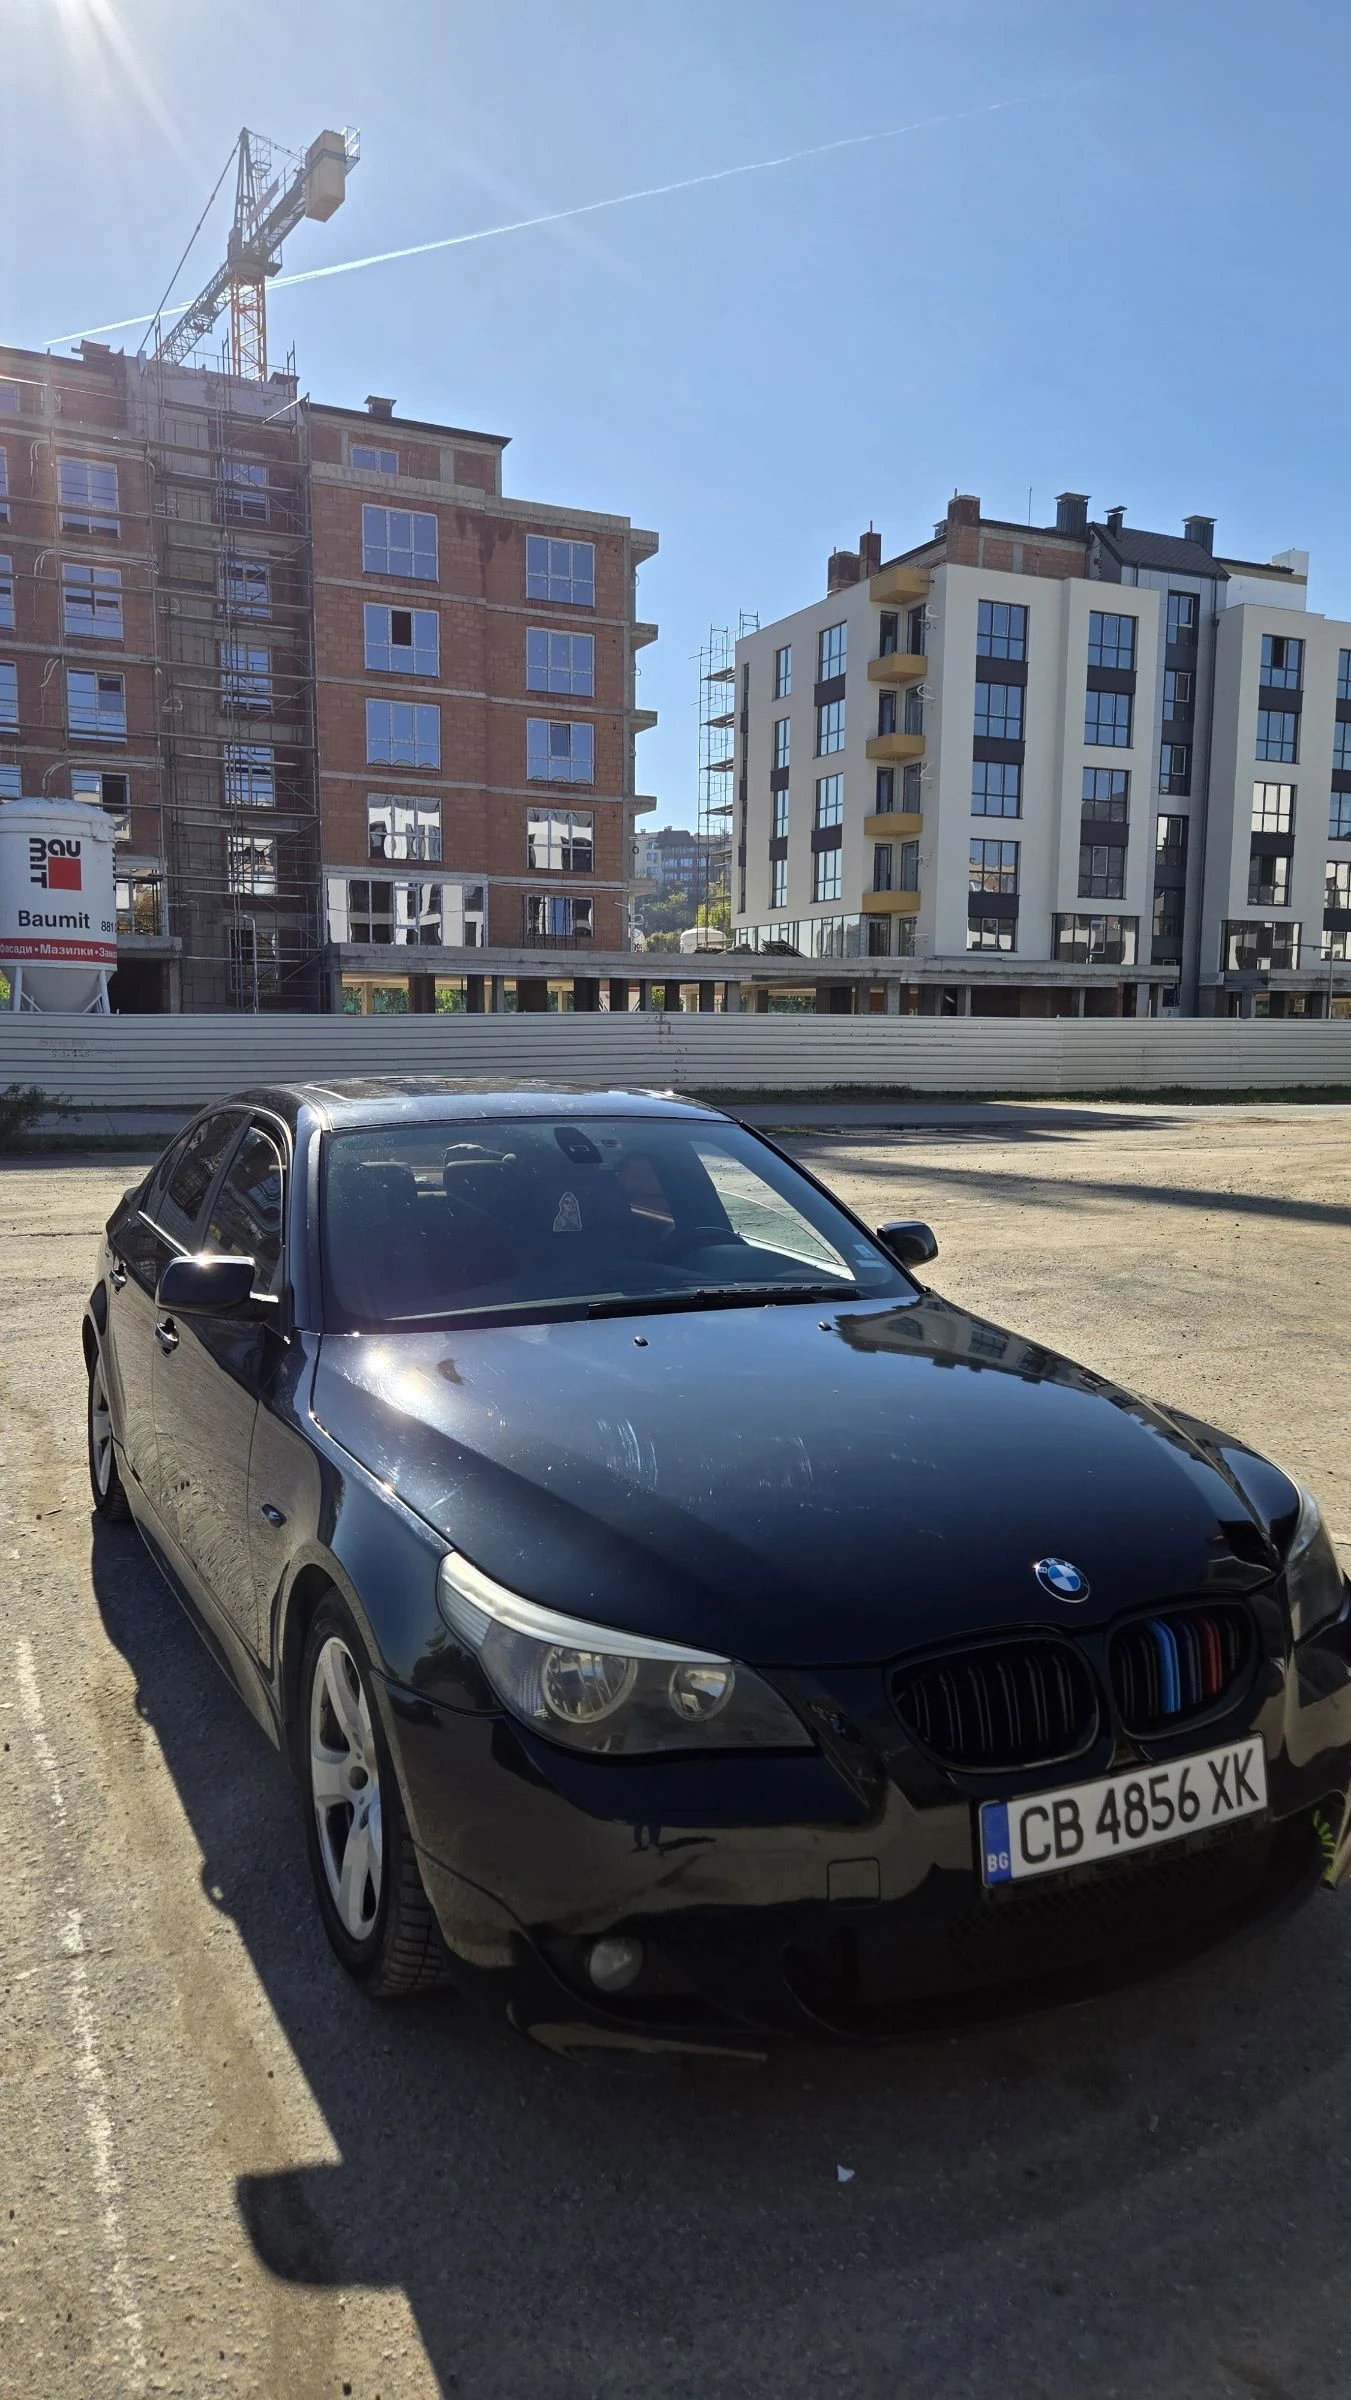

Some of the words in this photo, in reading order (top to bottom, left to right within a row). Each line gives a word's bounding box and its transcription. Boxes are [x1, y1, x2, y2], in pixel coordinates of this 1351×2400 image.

[18, 910, 90, 929] Baumit
[40, 944, 93, 956] Мазилки
[987, 1852, 1009, 1873] BG
[1019, 1798, 1084, 1865] CB
[1096, 1767, 1201, 1845] 4856
[1207, 1747, 1259, 1816] XK
